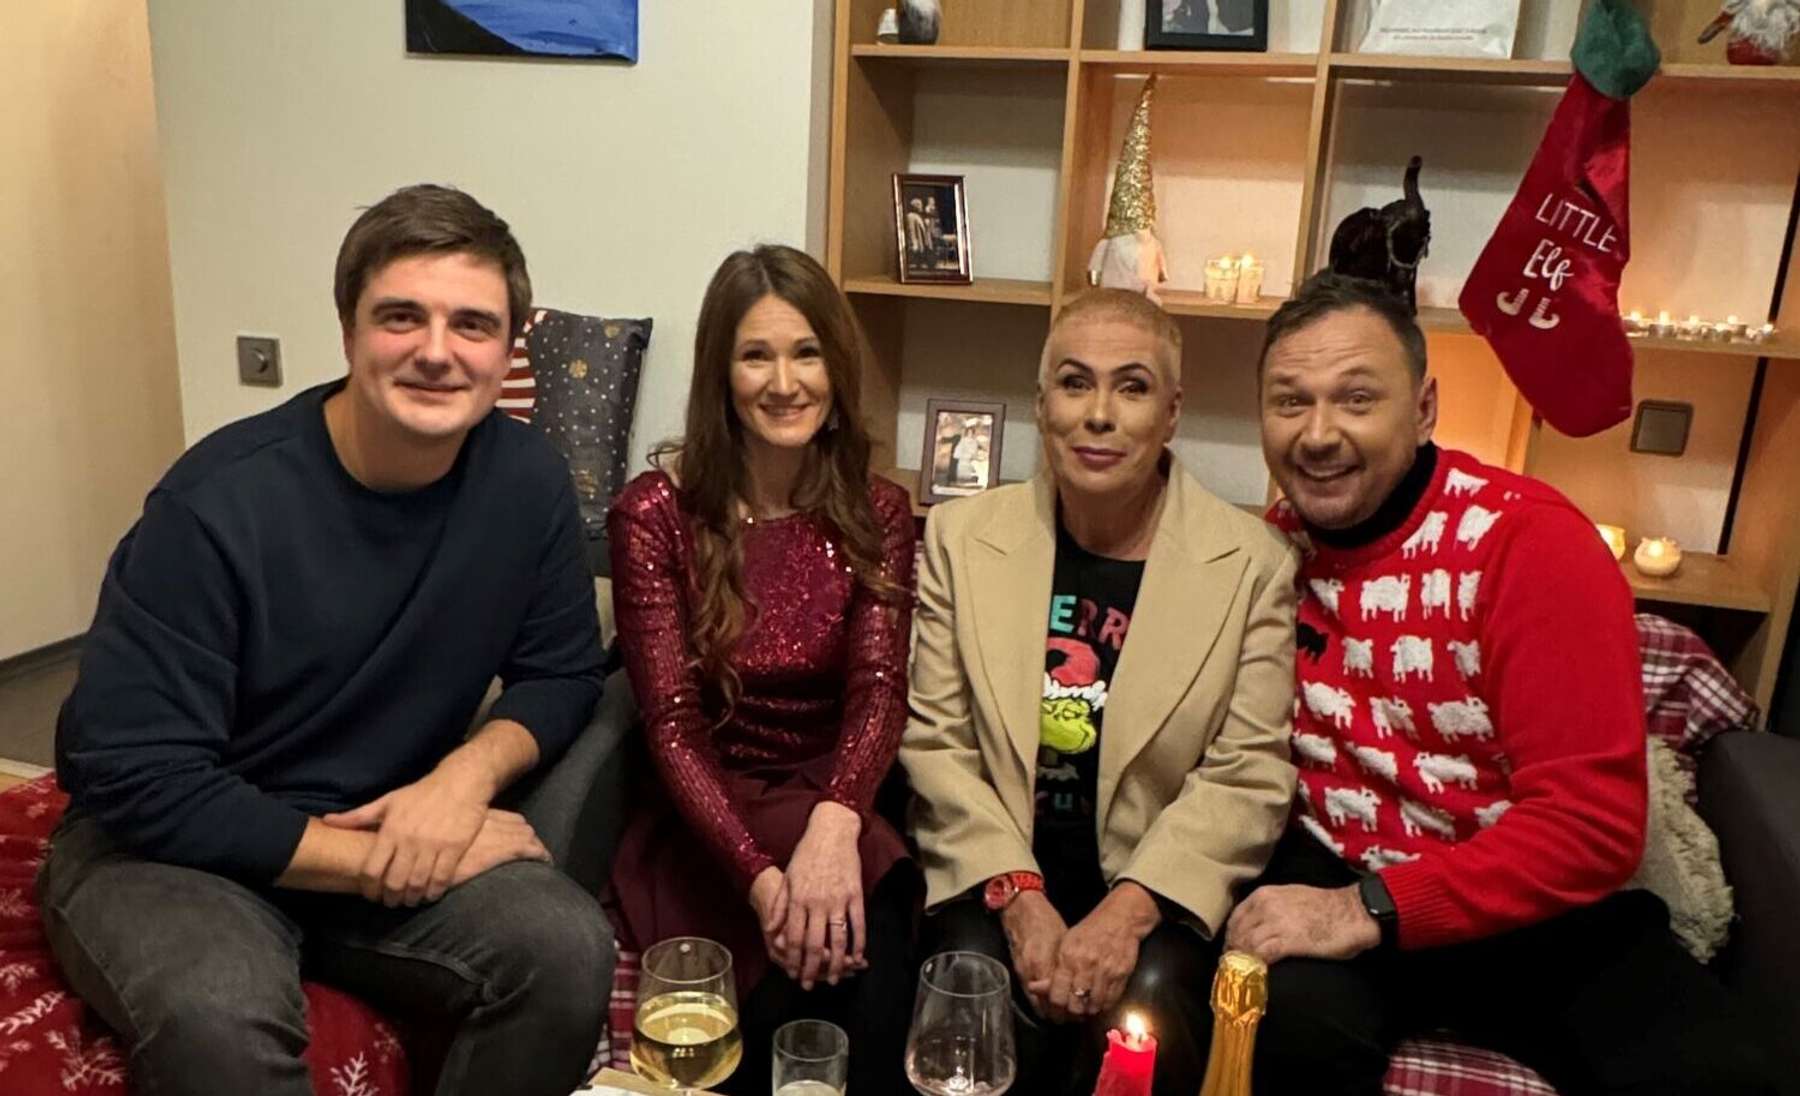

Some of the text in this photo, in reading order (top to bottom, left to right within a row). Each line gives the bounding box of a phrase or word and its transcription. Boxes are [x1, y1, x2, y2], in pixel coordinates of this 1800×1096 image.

[1535, 193, 1617, 252] LITTLE
[1523, 238, 1574, 291] Elf
[1050, 594, 1130, 651] ERR
